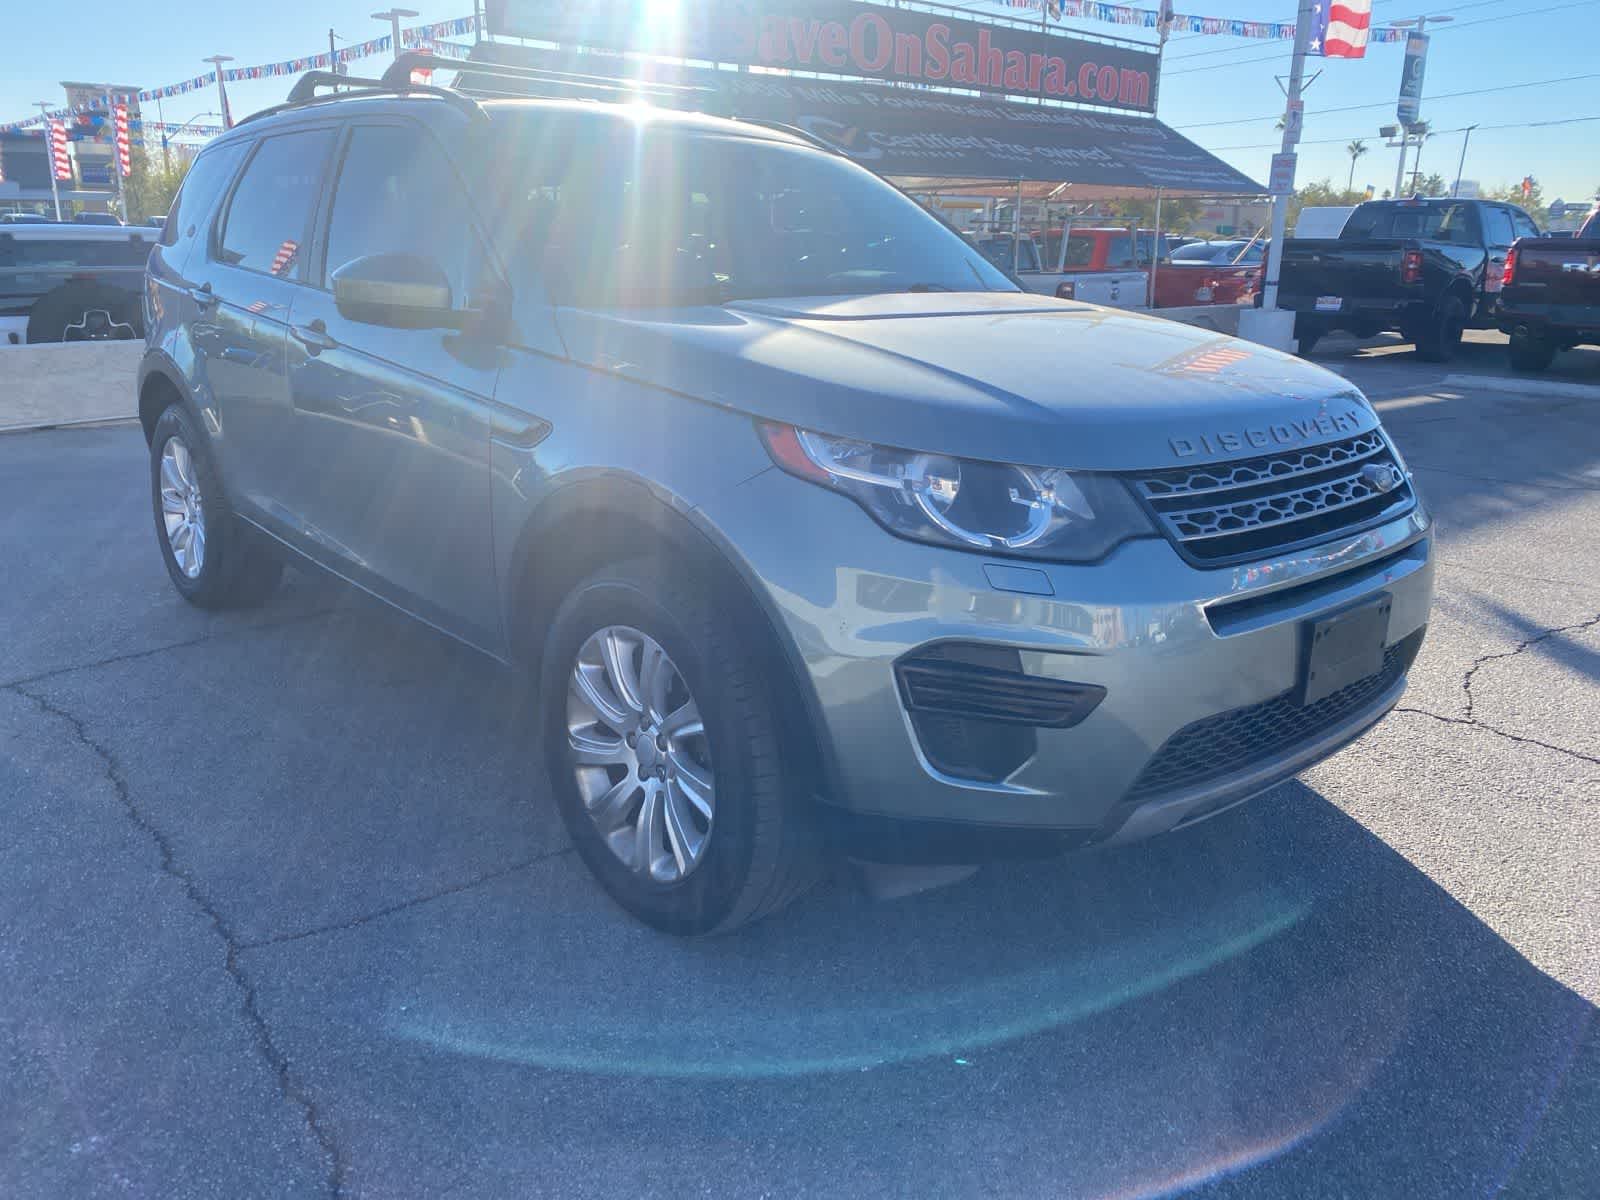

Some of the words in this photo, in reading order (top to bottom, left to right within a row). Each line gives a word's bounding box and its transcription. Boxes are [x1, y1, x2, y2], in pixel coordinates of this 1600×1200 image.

[733, 12, 1151, 107] SaveOnSahara.com
[865, 131, 987, 149] Certified
[1168, 411, 1360, 457] DISCOVERY
